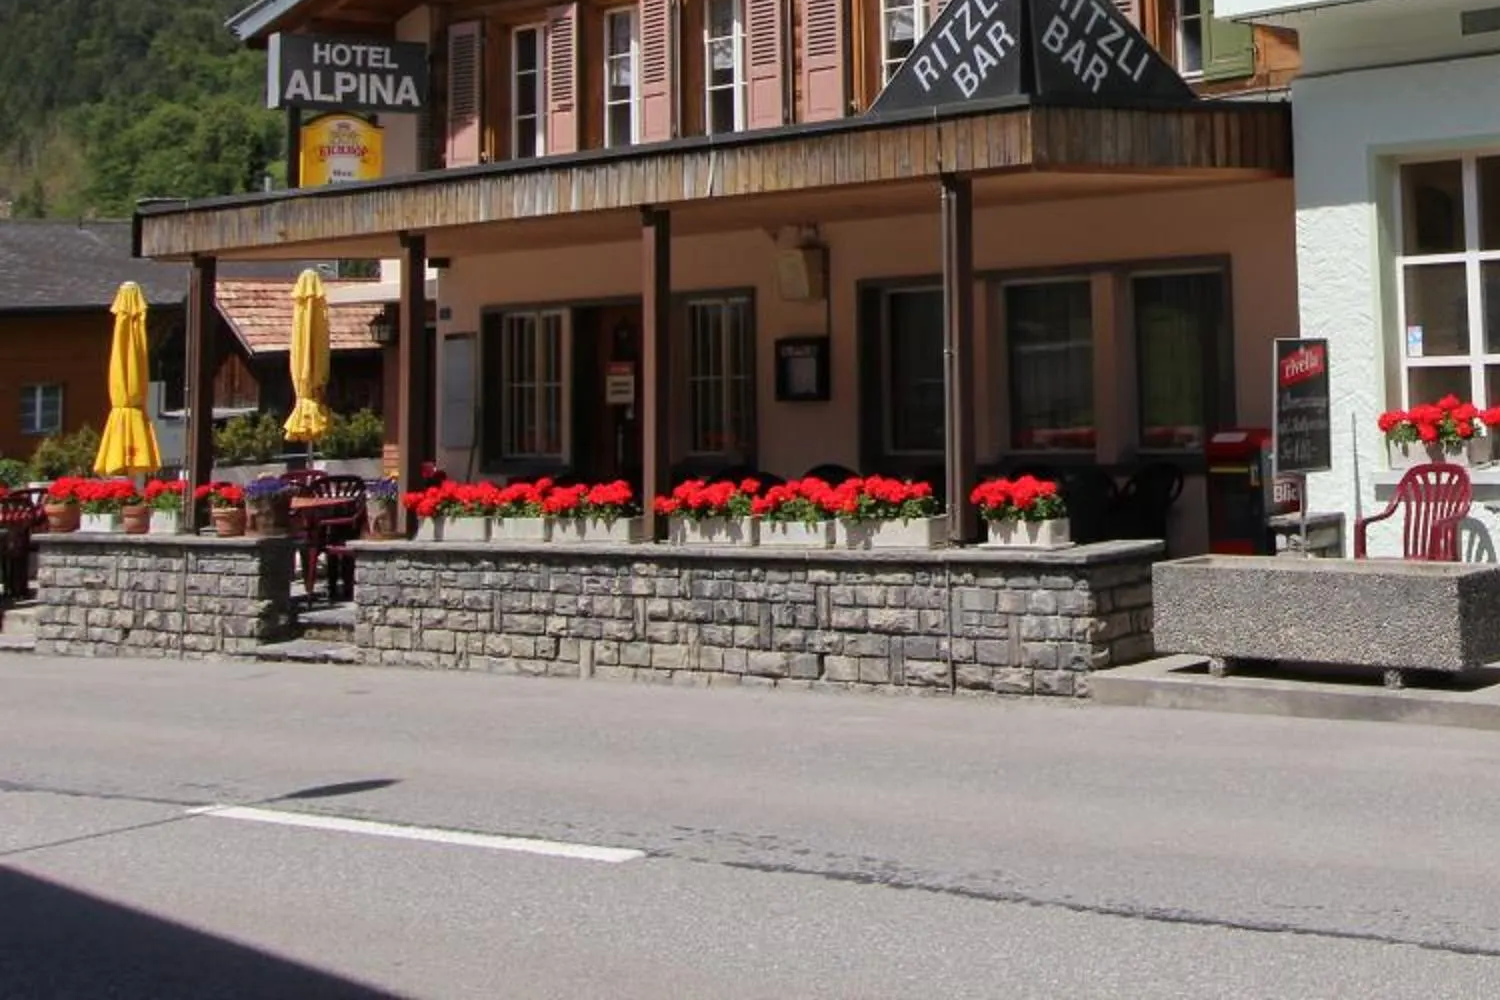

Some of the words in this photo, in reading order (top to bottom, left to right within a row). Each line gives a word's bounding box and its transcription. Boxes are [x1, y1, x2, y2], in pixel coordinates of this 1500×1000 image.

[312, 42, 399, 70] HOTEL
[951, 19, 1016, 99] BAR
[1040, 15, 1109, 94] BAR
[283, 68, 422, 107] ALPINA
